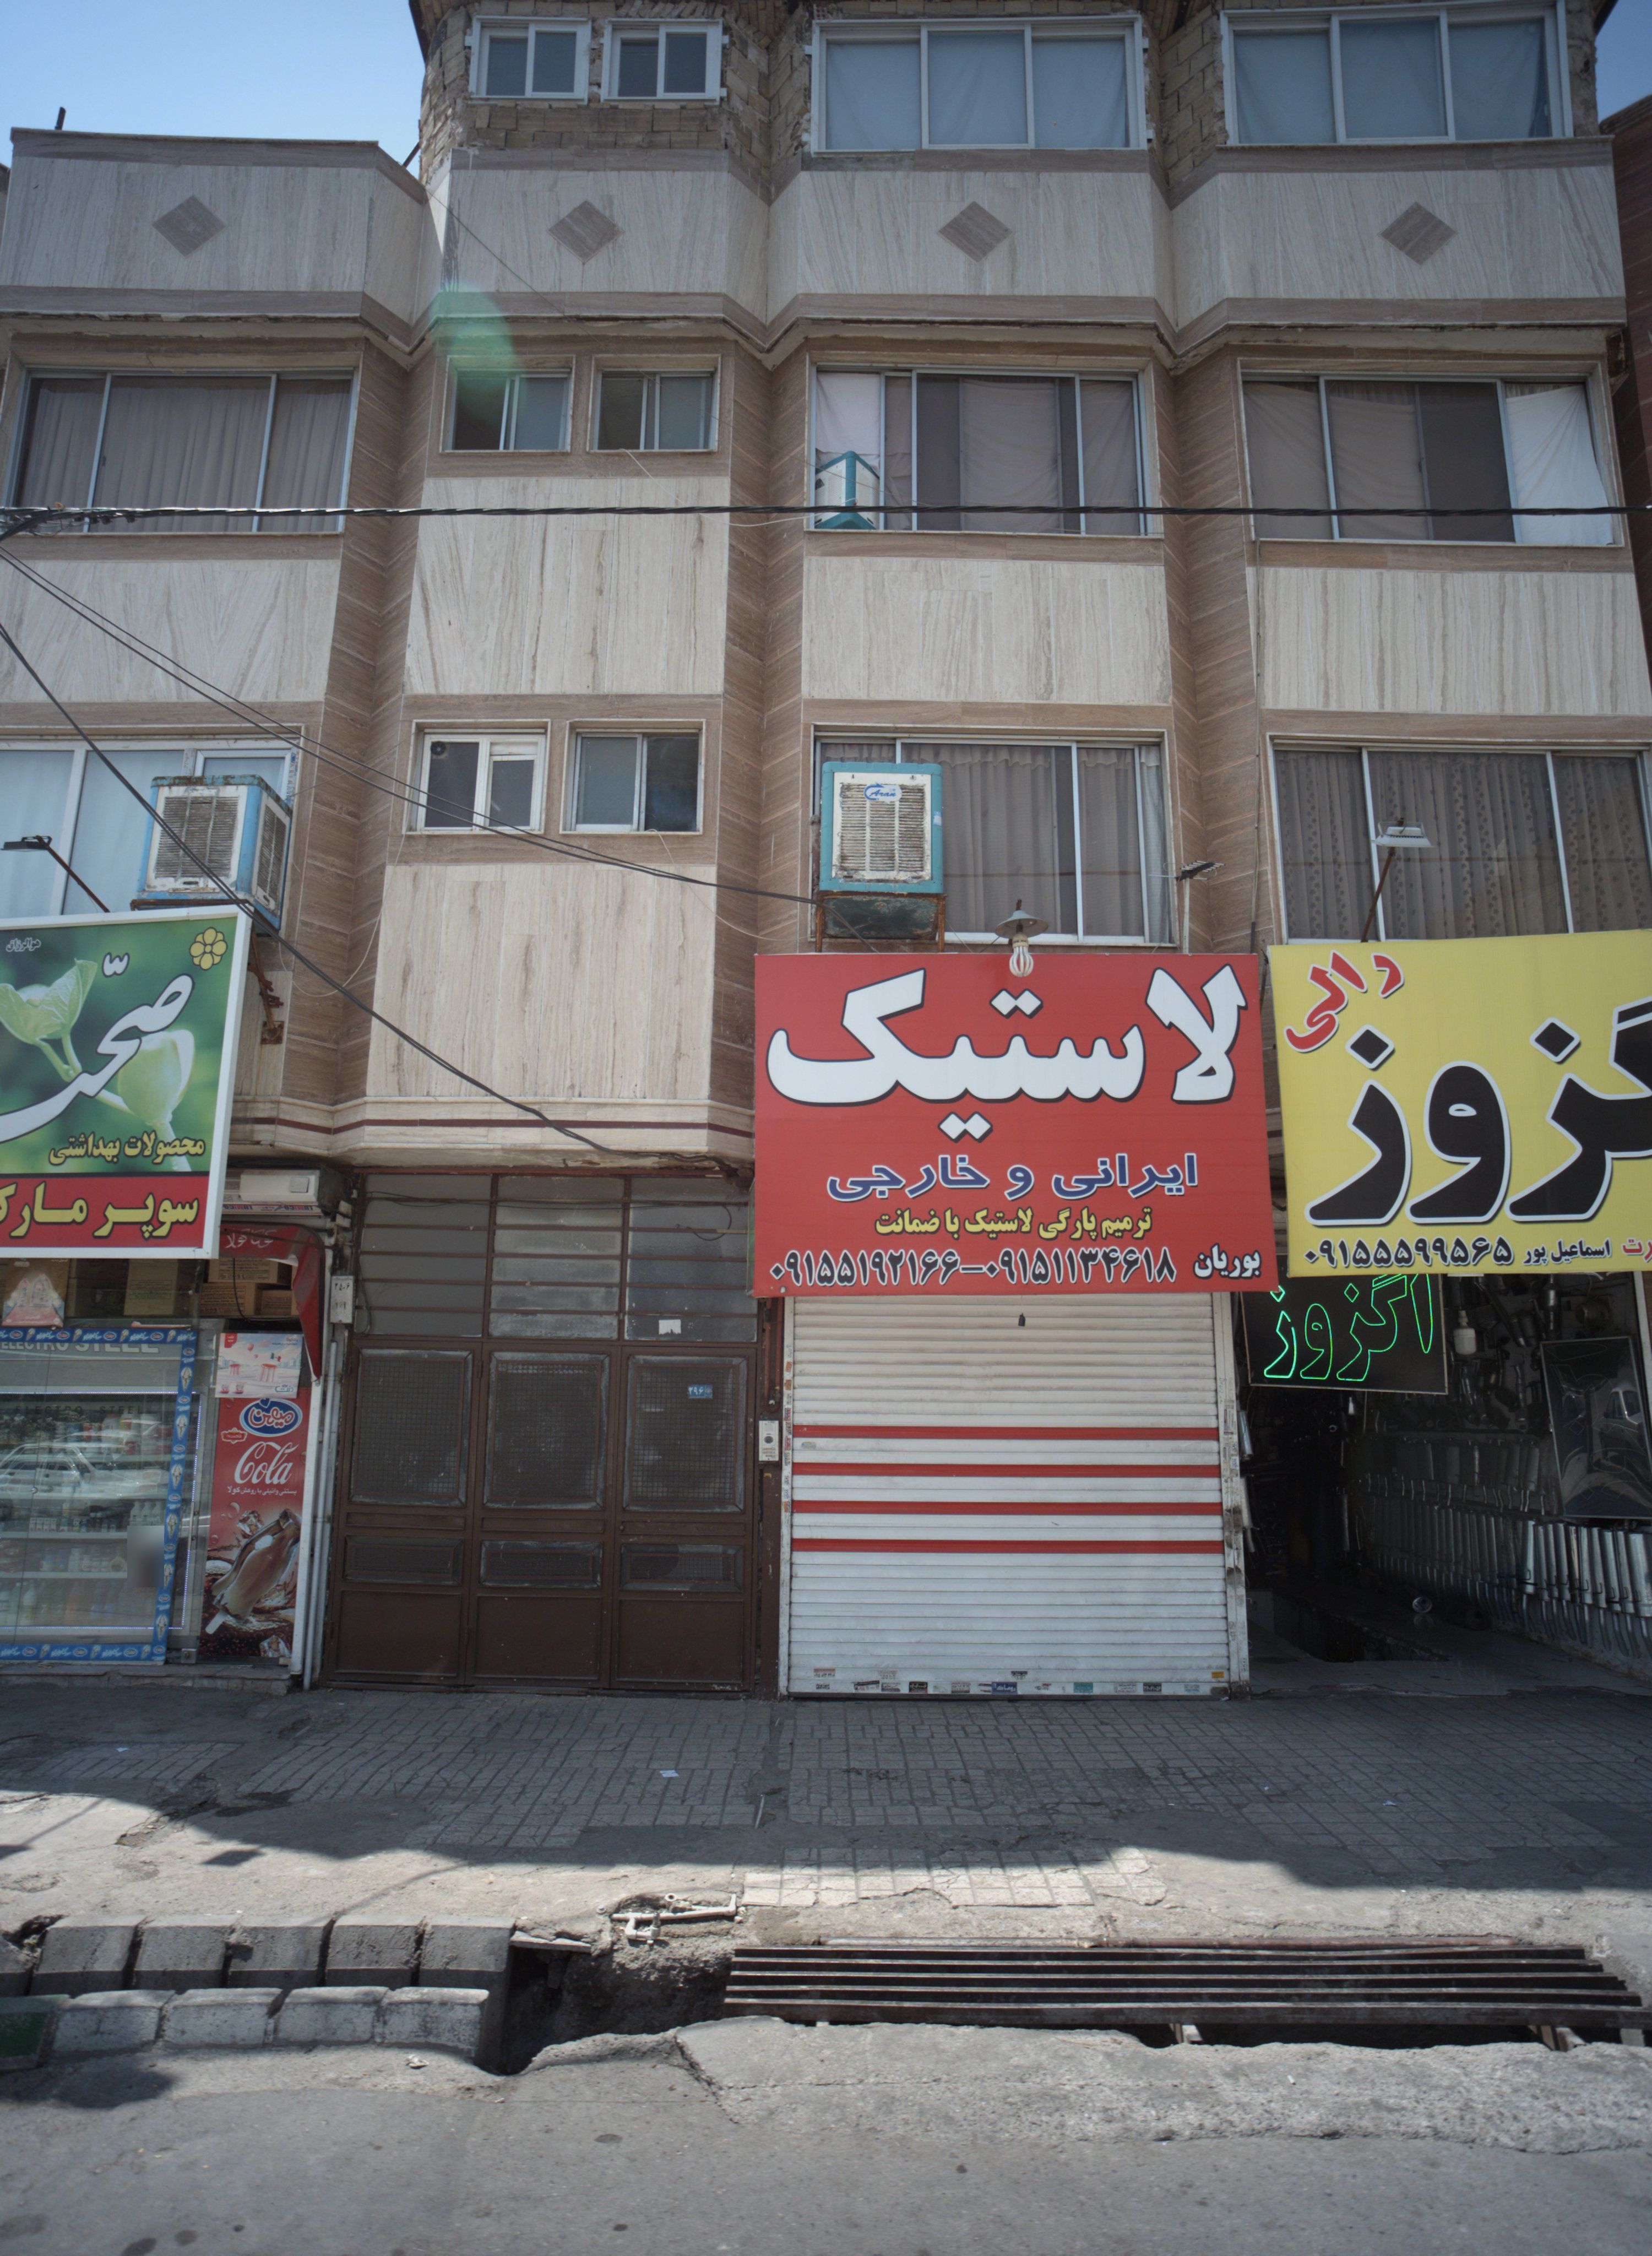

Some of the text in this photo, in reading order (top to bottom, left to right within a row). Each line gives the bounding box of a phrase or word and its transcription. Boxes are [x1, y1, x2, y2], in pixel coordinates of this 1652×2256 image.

[767, 963, 1248, 1142] لاستیک
[48, 1130, 206, 1165] محصولات بهداشتی
[827, 1152, 1199, 1202] ایرانی و خارجی
[93, 1192, 199, 1241] سوپر
[874, 1205, 1153, 1241] ترمیم پارگی لاستیک با ضمانت
[1192, 1242, 1262, 1281] بوریان
[1304, 1235, 1514, 1268] ۰۹۱۵۵۵۹۹۵۶۵
[1523, 1243, 1548, 1266] پور
[1550, 1238, 1612, 1263] اسماعیل
[248, 1406, 295, 1429] میهن
[234, 1441, 300, 1485] Cola
